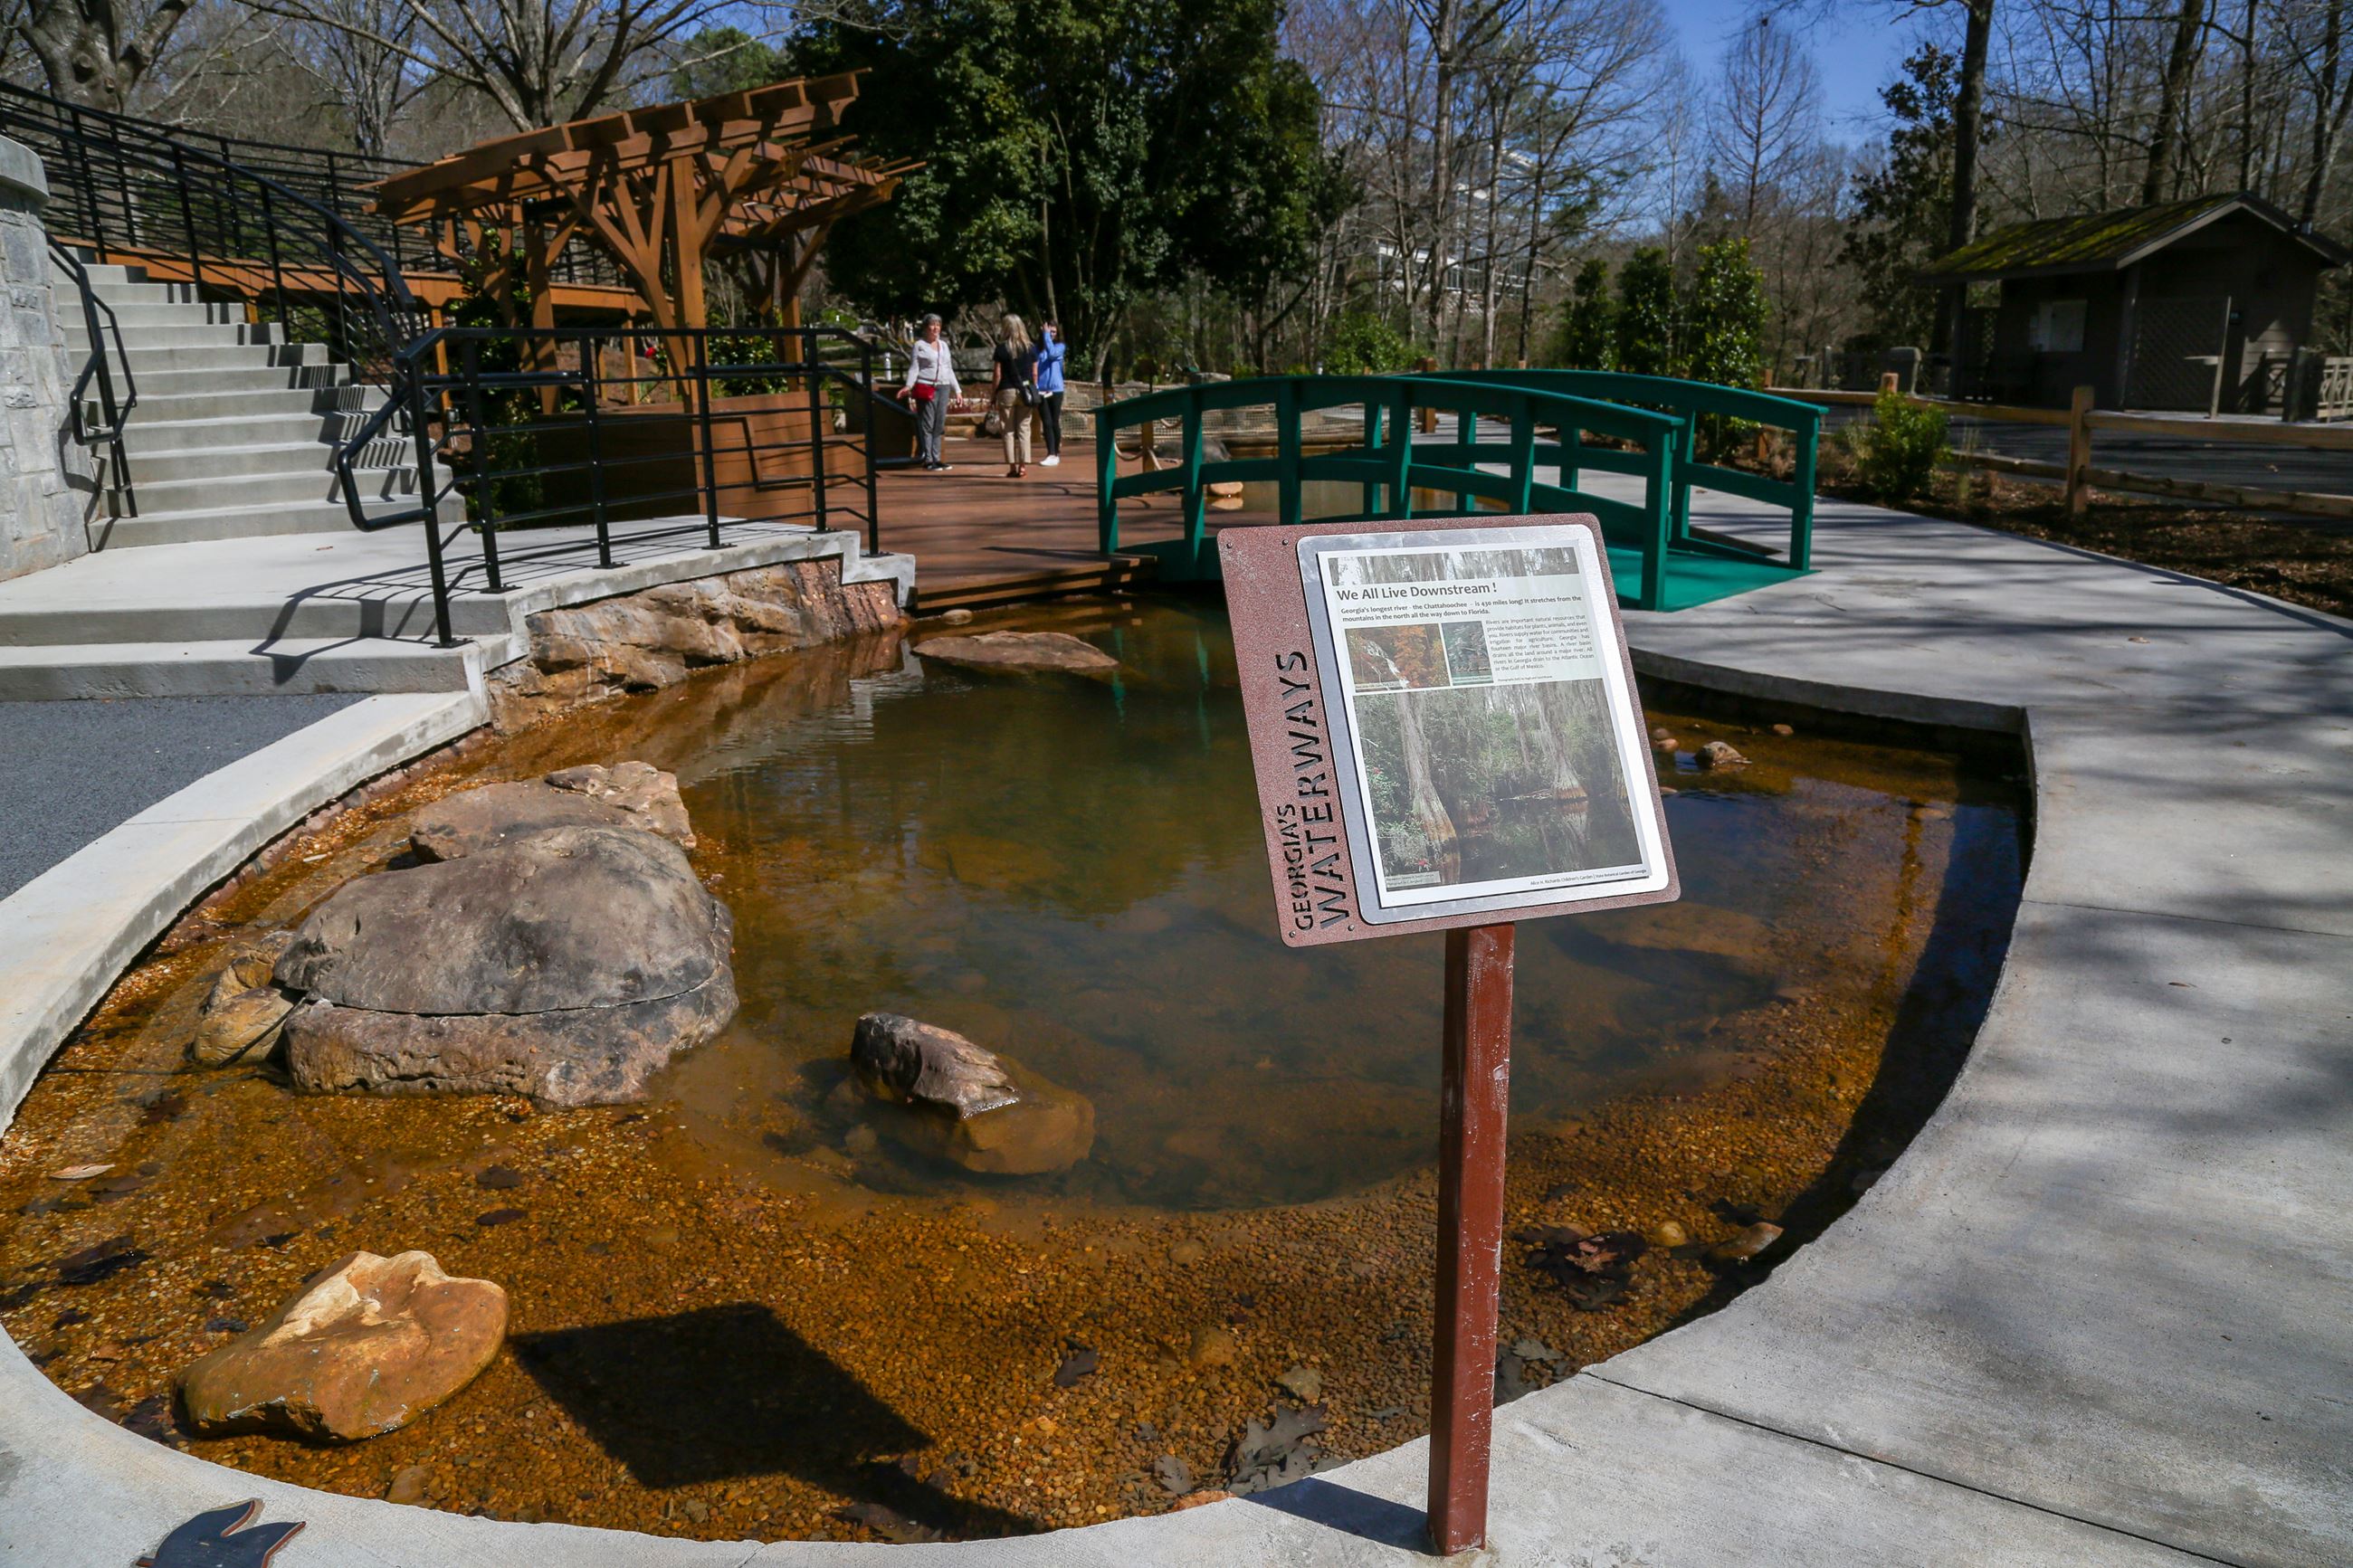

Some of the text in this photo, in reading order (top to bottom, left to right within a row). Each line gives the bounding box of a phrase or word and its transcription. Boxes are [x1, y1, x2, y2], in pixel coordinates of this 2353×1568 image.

[1337, 589, 1358, 601] We
[1362, 587, 1378, 599] All
[1381, 587, 1408, 598] Live
[1410, 584, 1491, 597] Downstream
[1340, 606, 1369, 615] Georgia's
[1370, 605, 1393, 613] longest
[1424, 602, 1467, 610] Chattahoochee
[1342, 614, 1375, 622] mountains
[1275, 651, 1349, 929] WATERWAYS
[1277, 803, 1313, 930] GEORGIA'S
